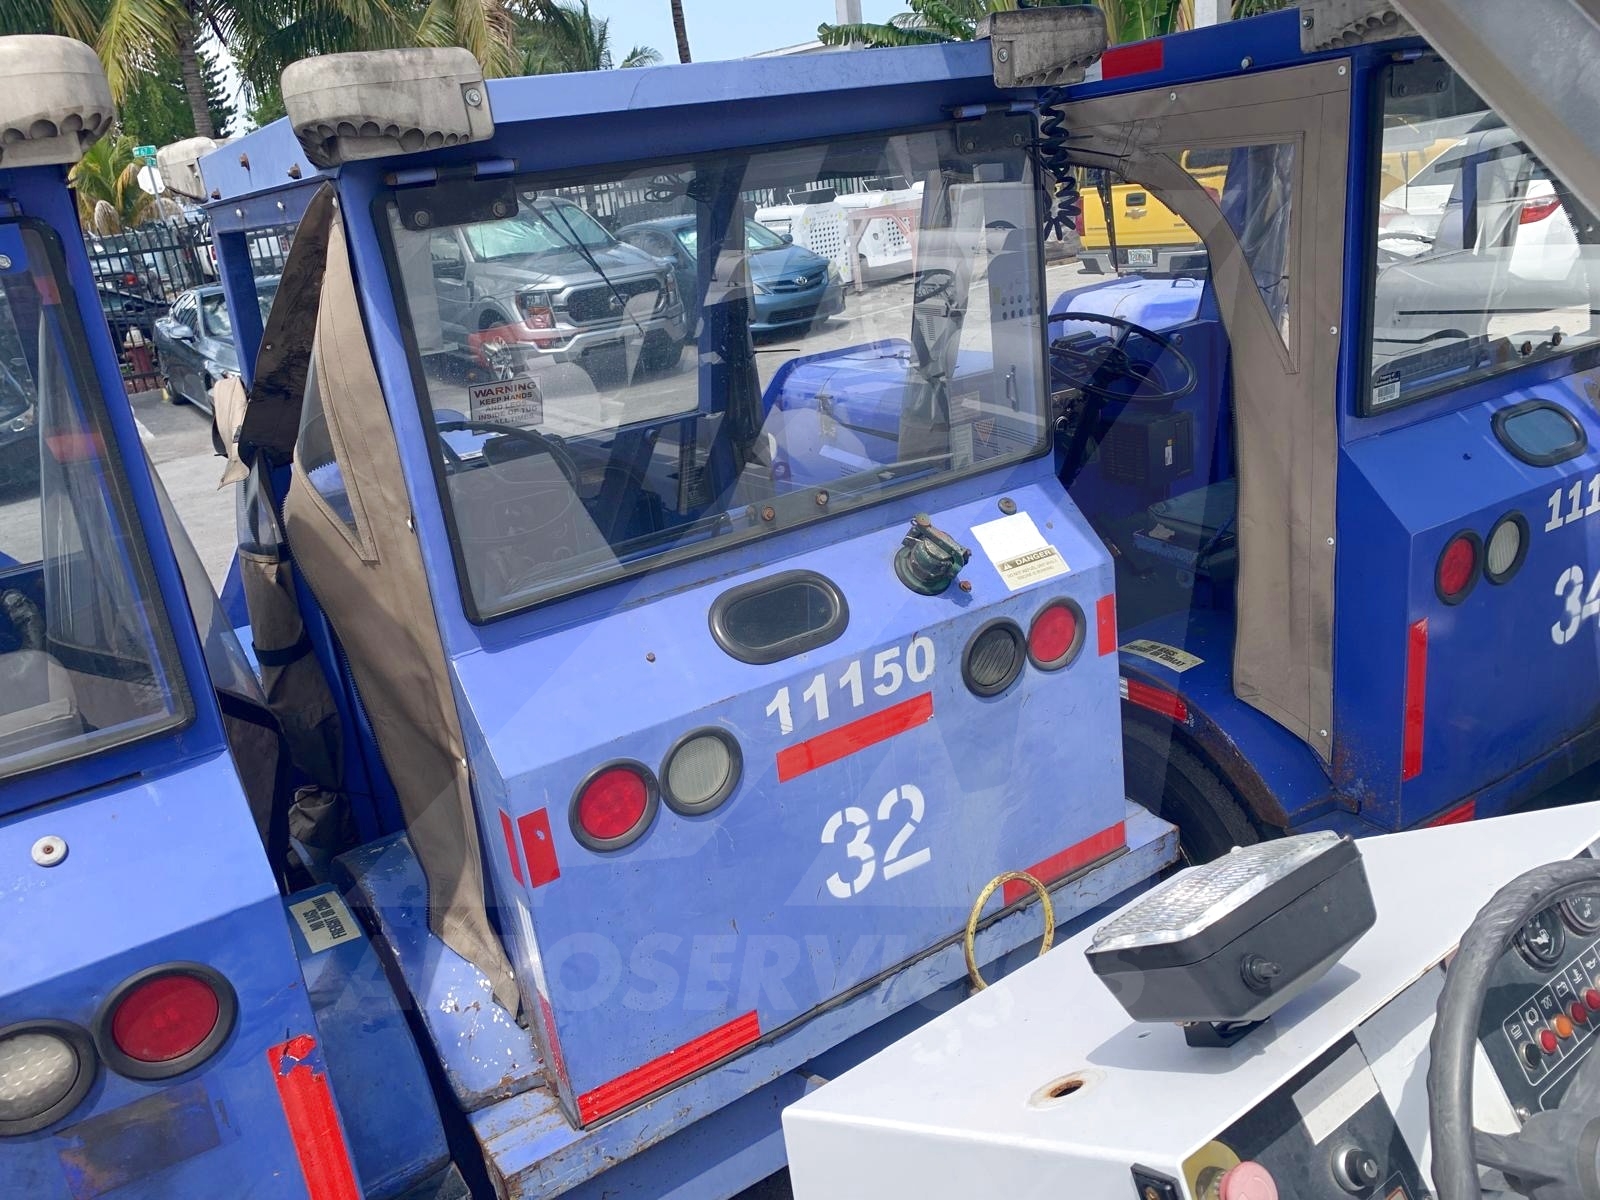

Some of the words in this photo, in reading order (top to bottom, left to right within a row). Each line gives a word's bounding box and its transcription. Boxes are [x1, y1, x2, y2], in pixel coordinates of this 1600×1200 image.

[474, 381, 537, 398] WARNING
[479, 396, 502, 406] KEEP
[503, 392, 533, 402] HANDS
[1015, 549, 1053, 566] DANGER
[766, 636, 936, 735] 11150
[821, 784, 932, 899] 32
